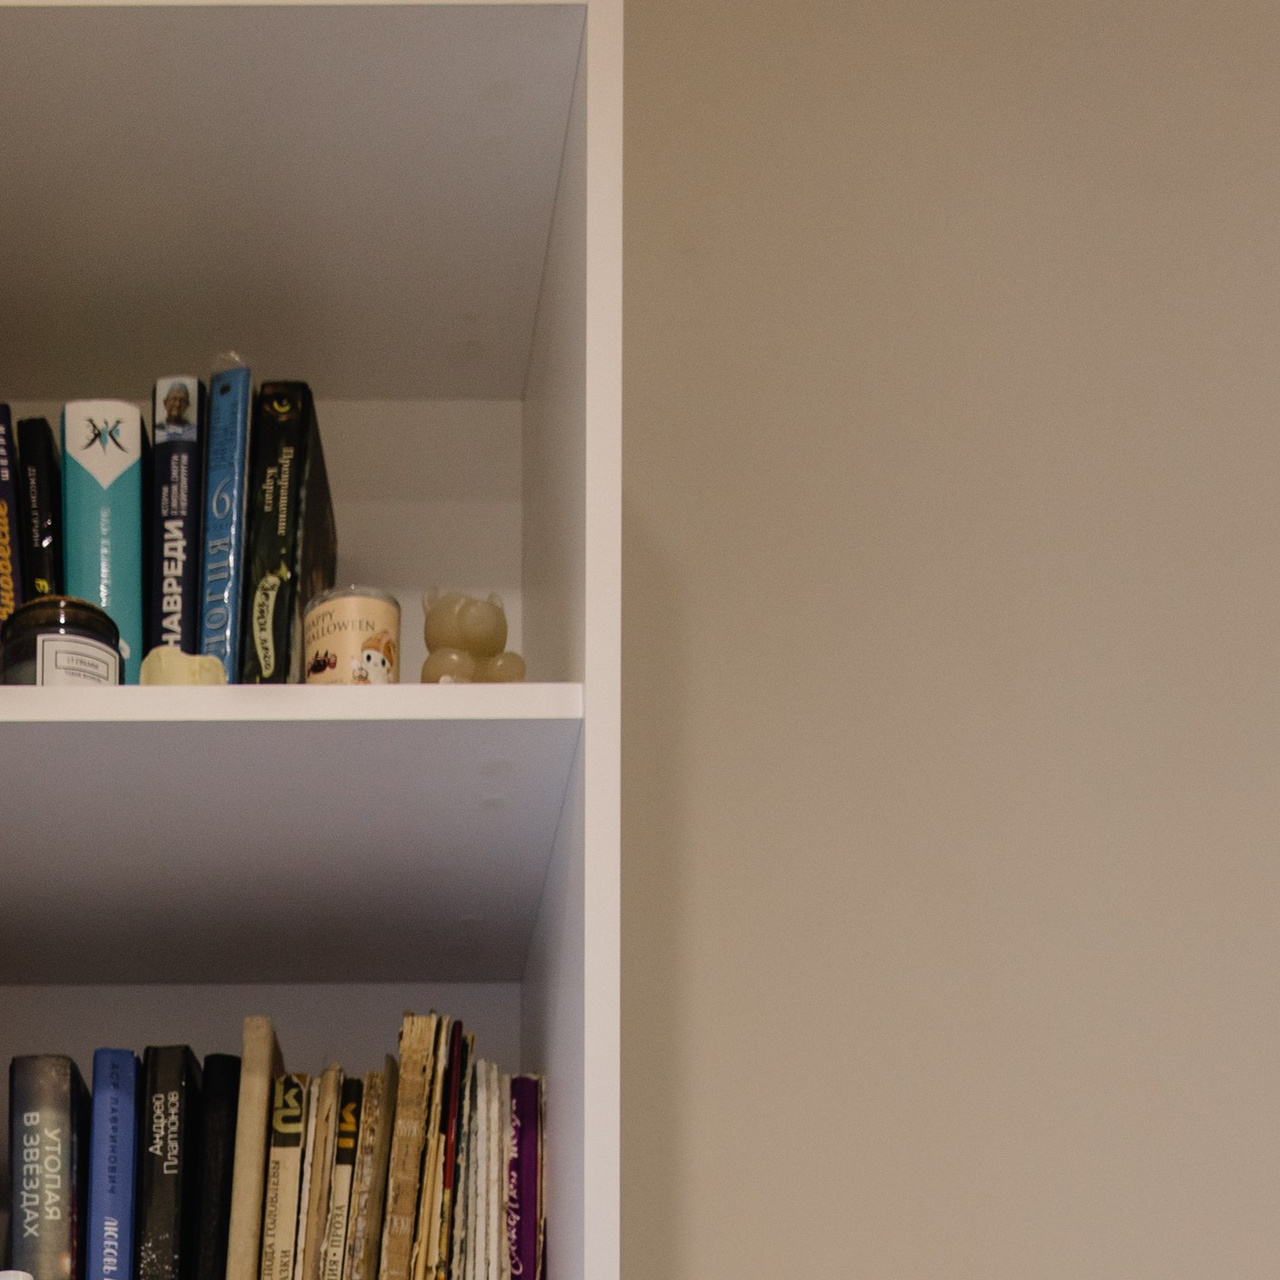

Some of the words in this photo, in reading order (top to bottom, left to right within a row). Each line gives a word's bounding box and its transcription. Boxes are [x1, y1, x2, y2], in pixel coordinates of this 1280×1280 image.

[23, 1111, 40, 1127] В
[163, 1091, 179, 1175] Платонов
[19, 1134, 43, 1238] ЗВЁЗДАХ
[44, 1127, 61, 1220] УТОПАЯ
[103, 1216, 118, 1274] ЛЮБОВЬ
[330, 1204, 346, 1248] ПРОЗА
